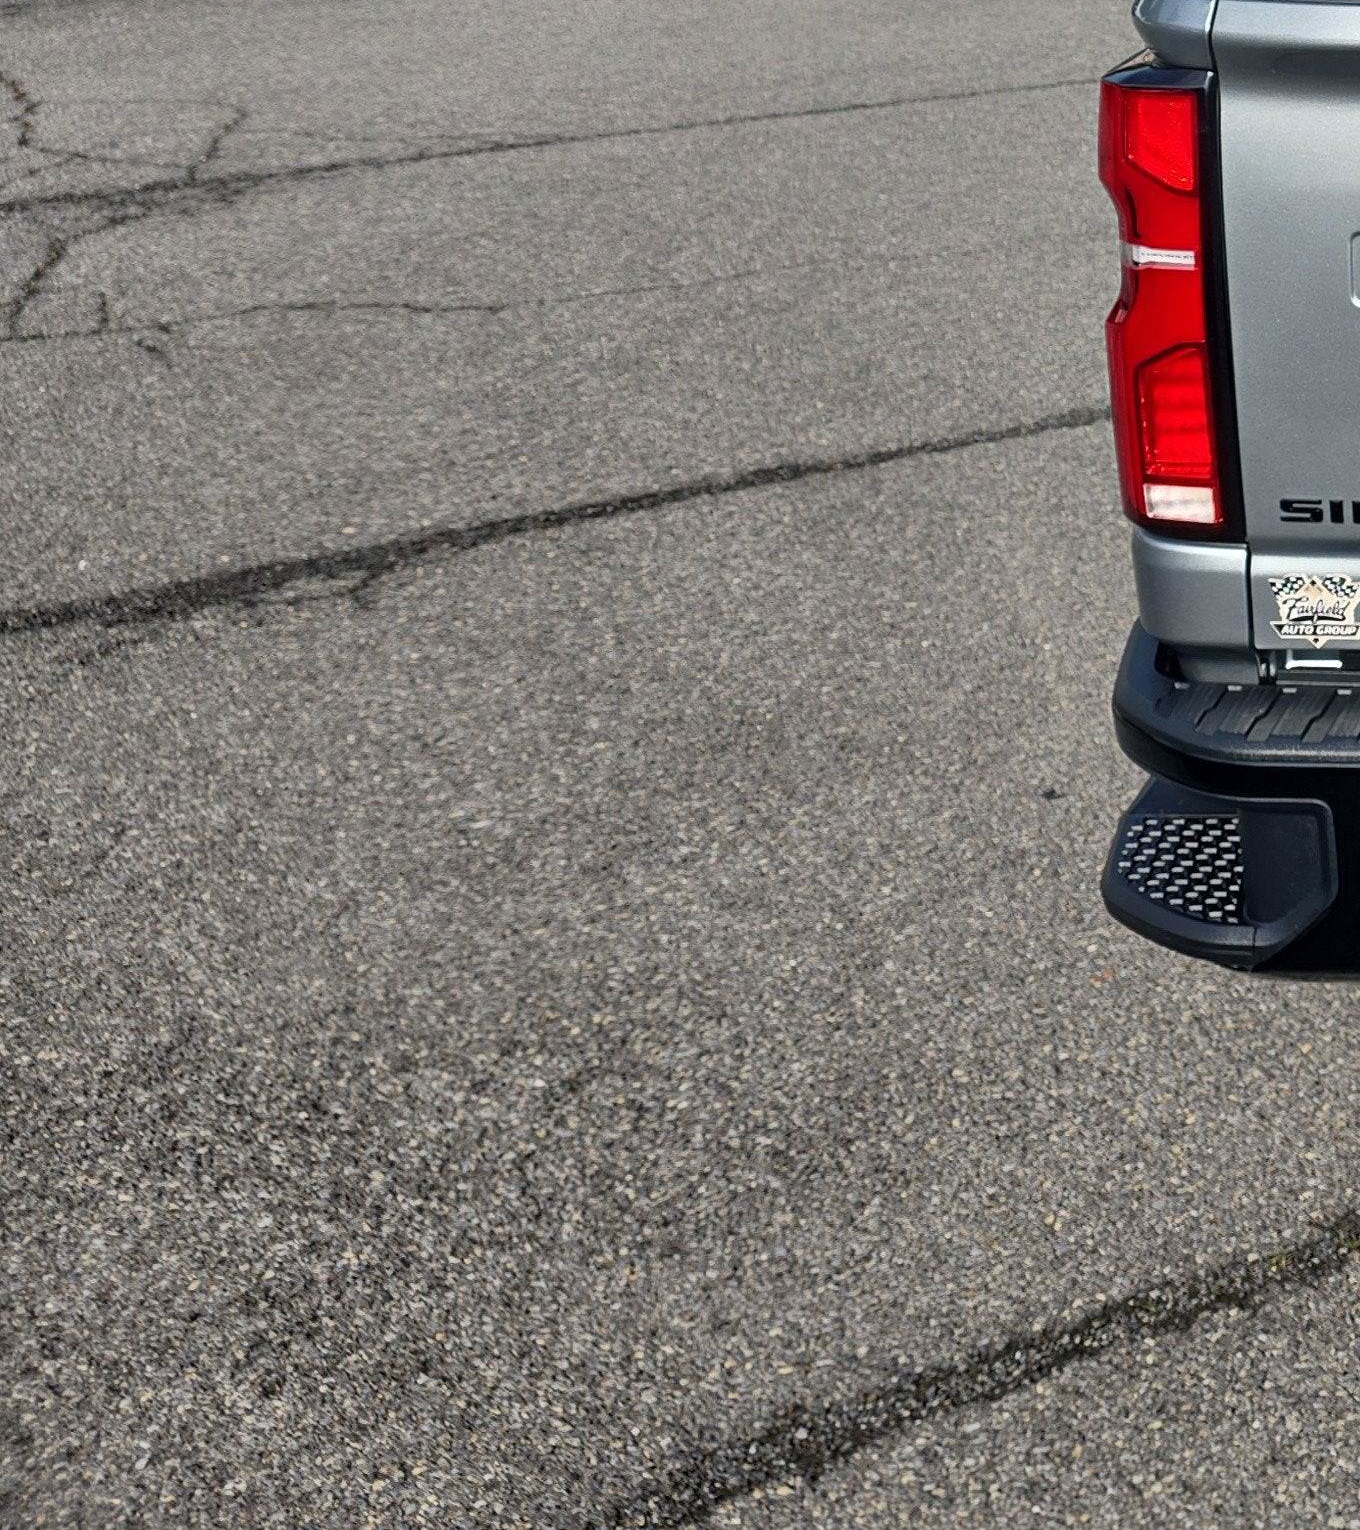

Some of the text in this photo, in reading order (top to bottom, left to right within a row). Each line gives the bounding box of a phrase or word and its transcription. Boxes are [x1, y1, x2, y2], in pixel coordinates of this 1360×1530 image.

[1282, 596, 1350, 623] Fairfield
[1281, 625, 1357, 636] AUTO GROUP
